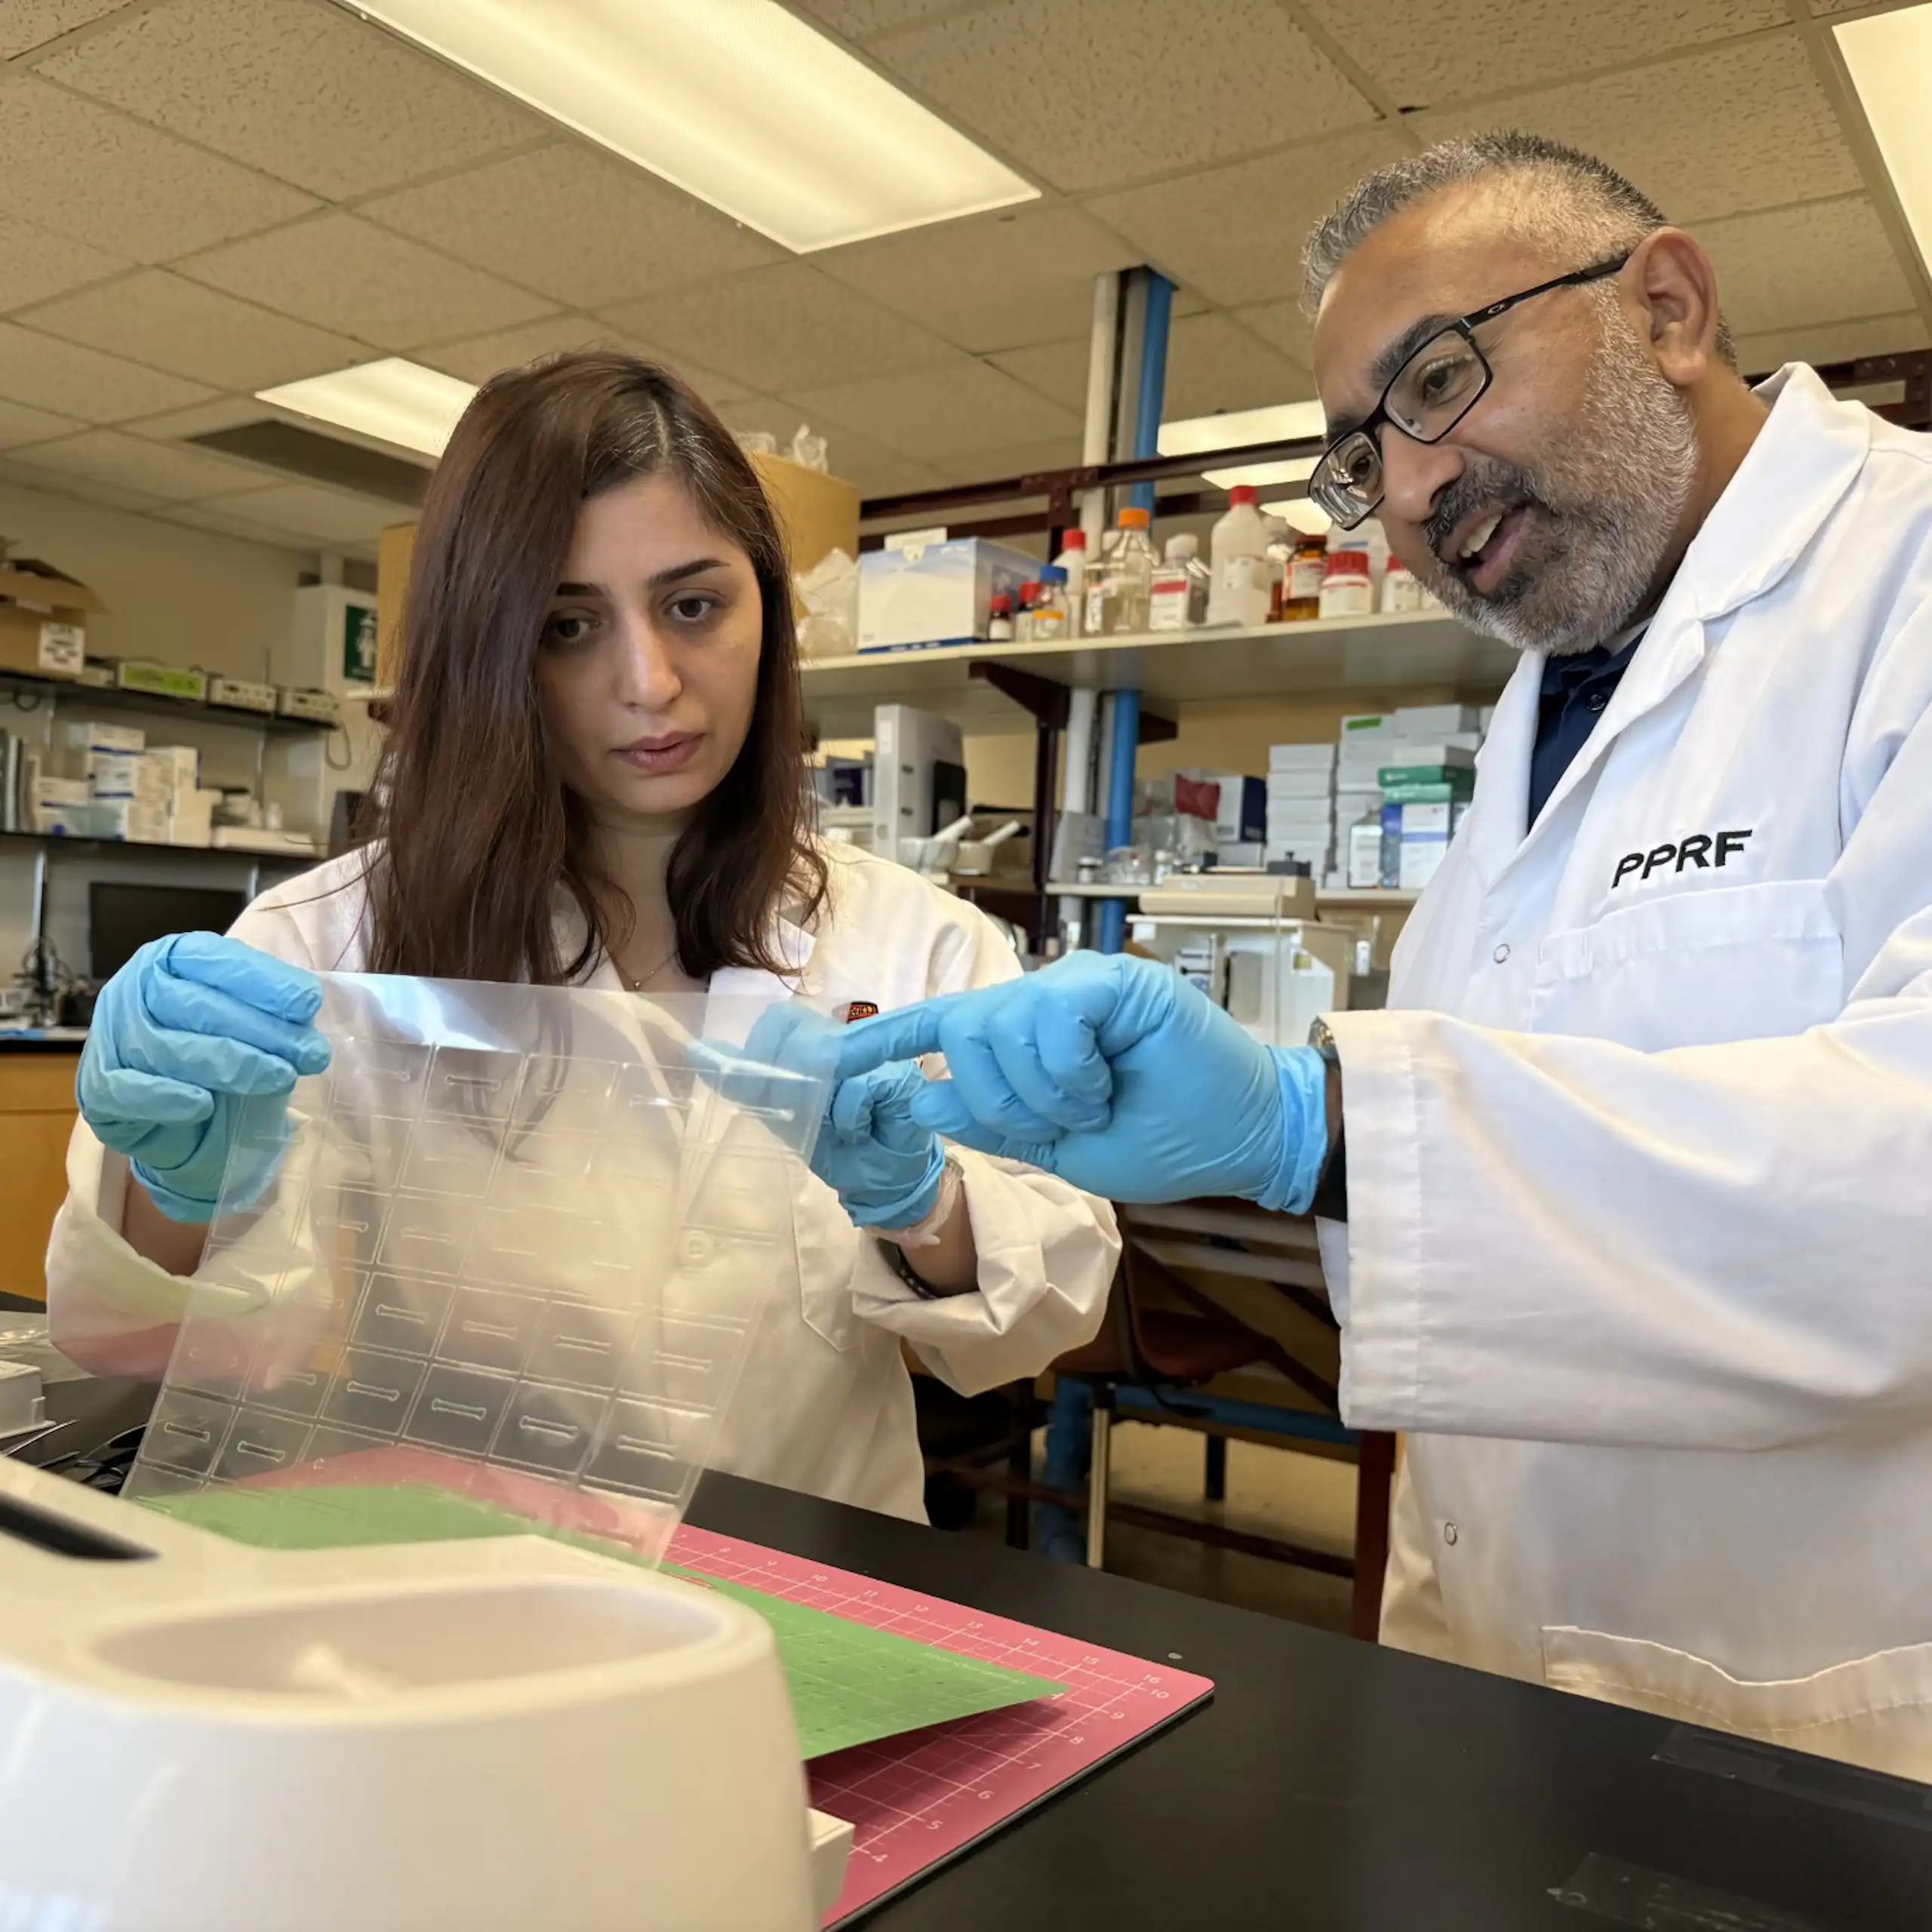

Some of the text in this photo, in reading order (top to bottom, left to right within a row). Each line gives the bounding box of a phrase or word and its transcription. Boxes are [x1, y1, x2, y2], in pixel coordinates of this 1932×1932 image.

[1611, 829, 1752, 888] PPRF
[811, 1574, 828, 1583] 10
[967, 1620, 983, 1629] 13
[1023, 1638, 1041, 1646] 14
[1081, 1655, 1100, 1664] 15
[1143, 1674, 1162, 1684] 16
[1149, 1688, 1170, 1699] 10
[1109, 1711, 1125, 1720] 9
[1069, 1735, 1084, 1745] 8
[977, 1790, 995, 1799] 6
[926, 1820, 944, 1830] 5
[870, 1854, 889, 1863] 4
